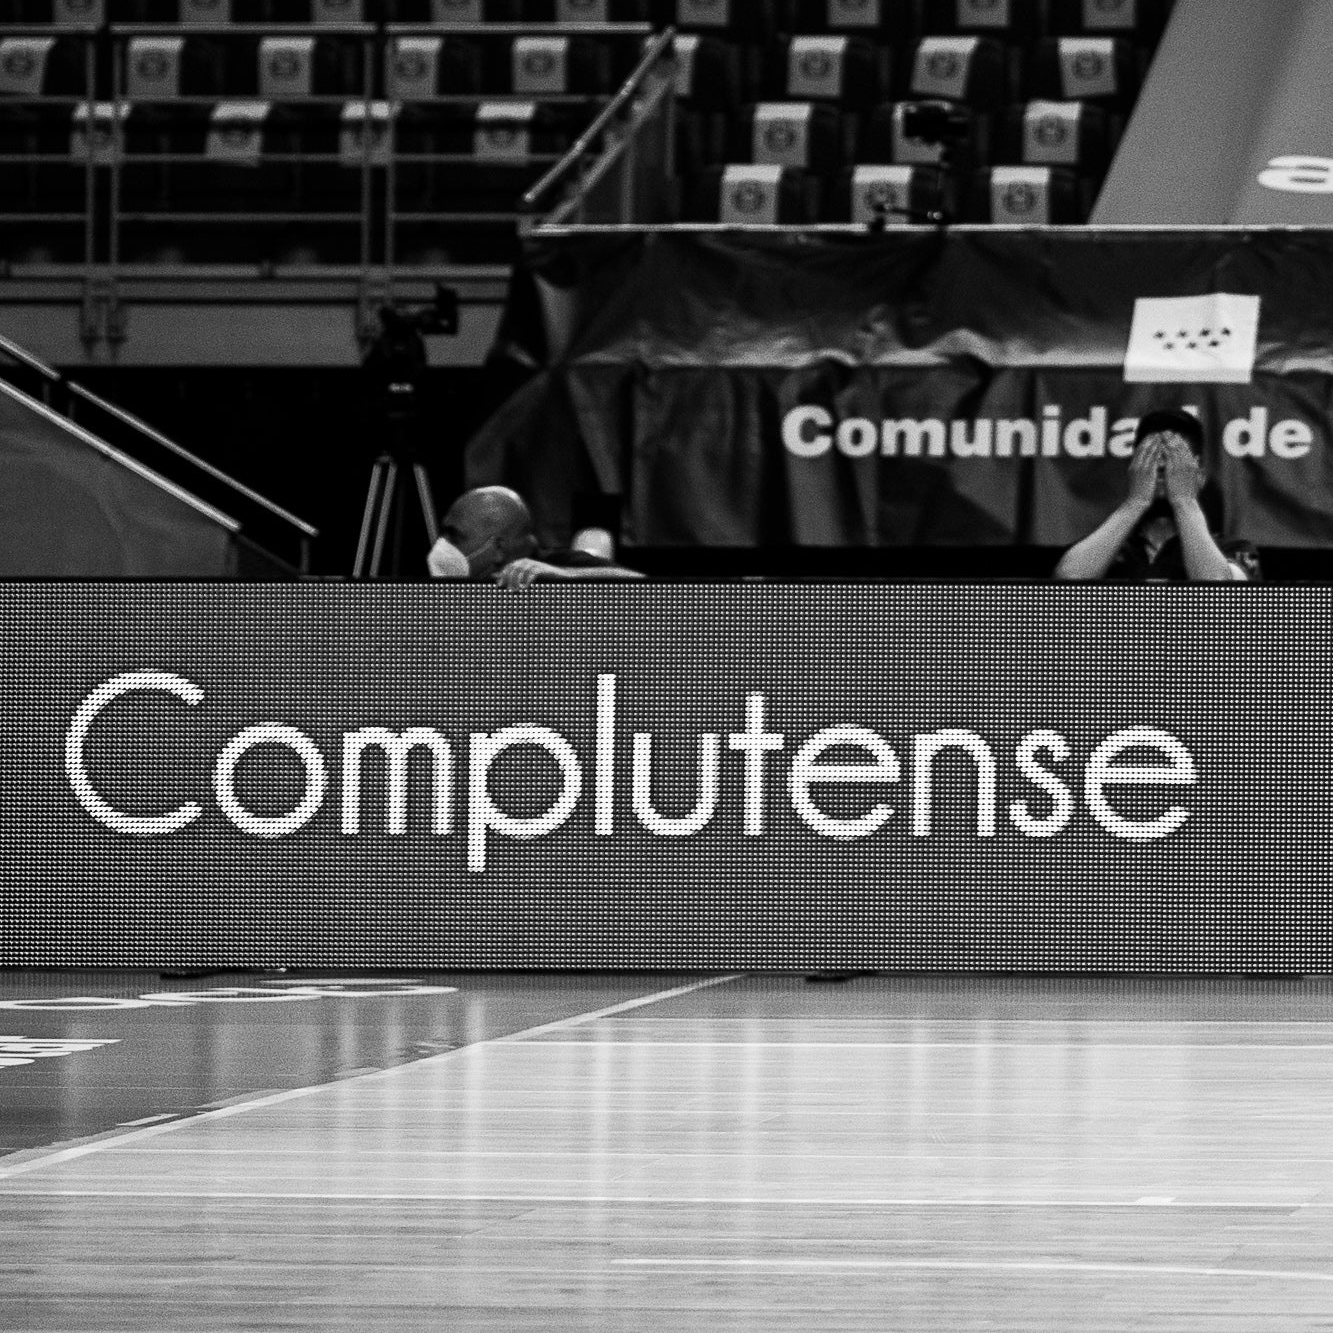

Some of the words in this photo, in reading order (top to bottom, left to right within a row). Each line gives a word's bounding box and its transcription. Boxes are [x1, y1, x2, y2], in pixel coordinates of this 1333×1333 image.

[782, 404, 1198, 459] Comunida
[1222, 406, 1314, 459] de
[64, 667, 1199, 873] Complutense
